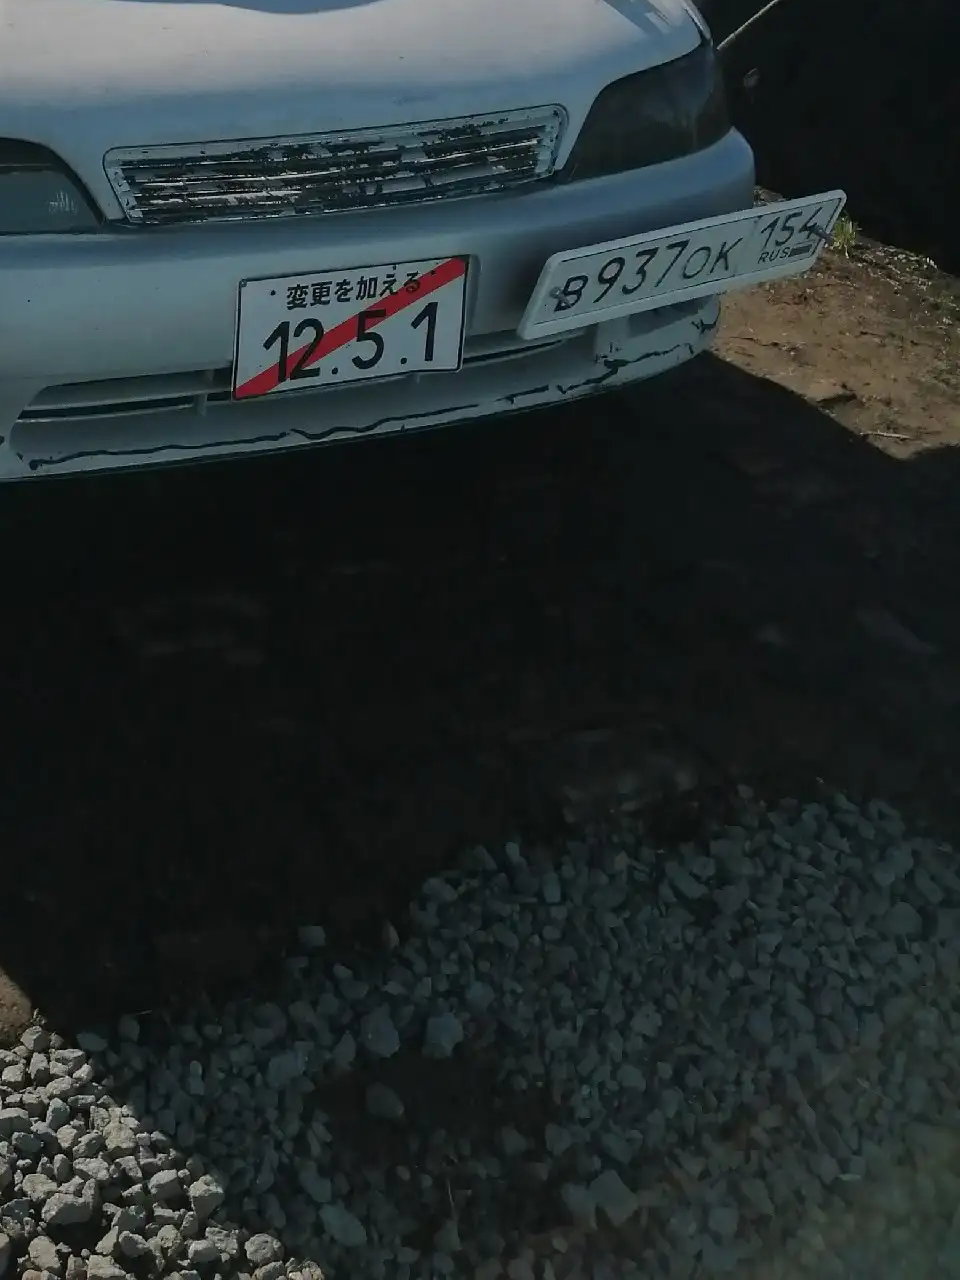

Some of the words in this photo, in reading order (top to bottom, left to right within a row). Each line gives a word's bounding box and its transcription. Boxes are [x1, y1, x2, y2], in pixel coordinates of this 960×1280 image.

[760, 206, 824, 249] 154
[758, 247, 790, 265] RUS
[286, 271, 421, 310] 変更を加える
[262, 301, 439, 384] 12.5.1
